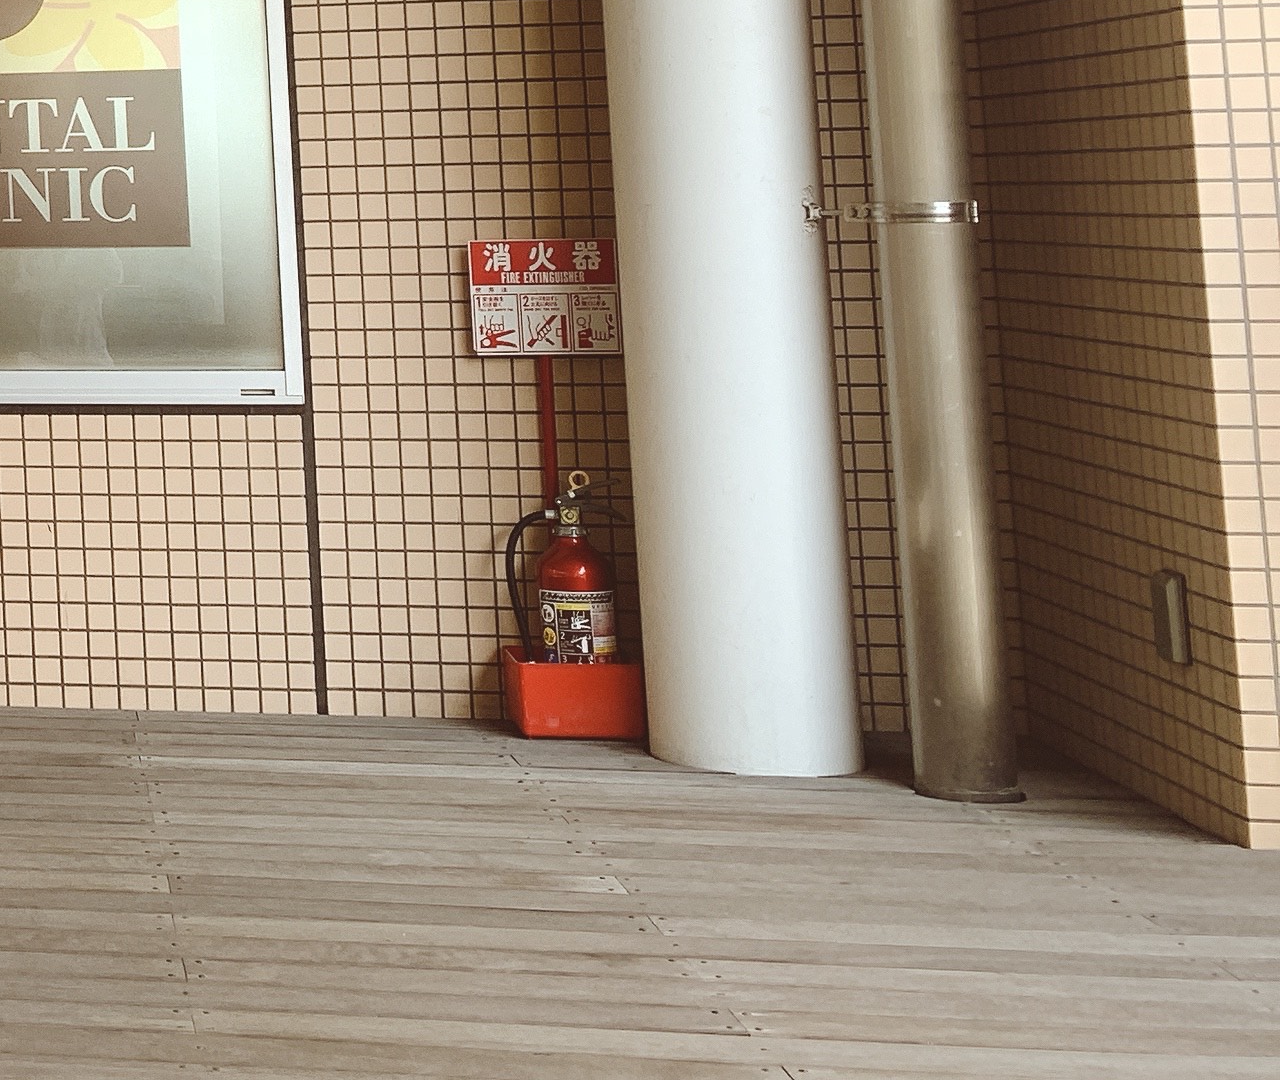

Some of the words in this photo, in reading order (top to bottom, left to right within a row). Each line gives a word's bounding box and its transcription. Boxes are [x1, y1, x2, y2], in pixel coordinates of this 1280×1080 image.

[482, 241, 602, 272] 消火器
[501, 271, 521, 284] FIRE
[523, 271, 586, 284] EXTINGUISHER
[522, 295, 530, 307] 2
[573, 295, 581, 307] 3
